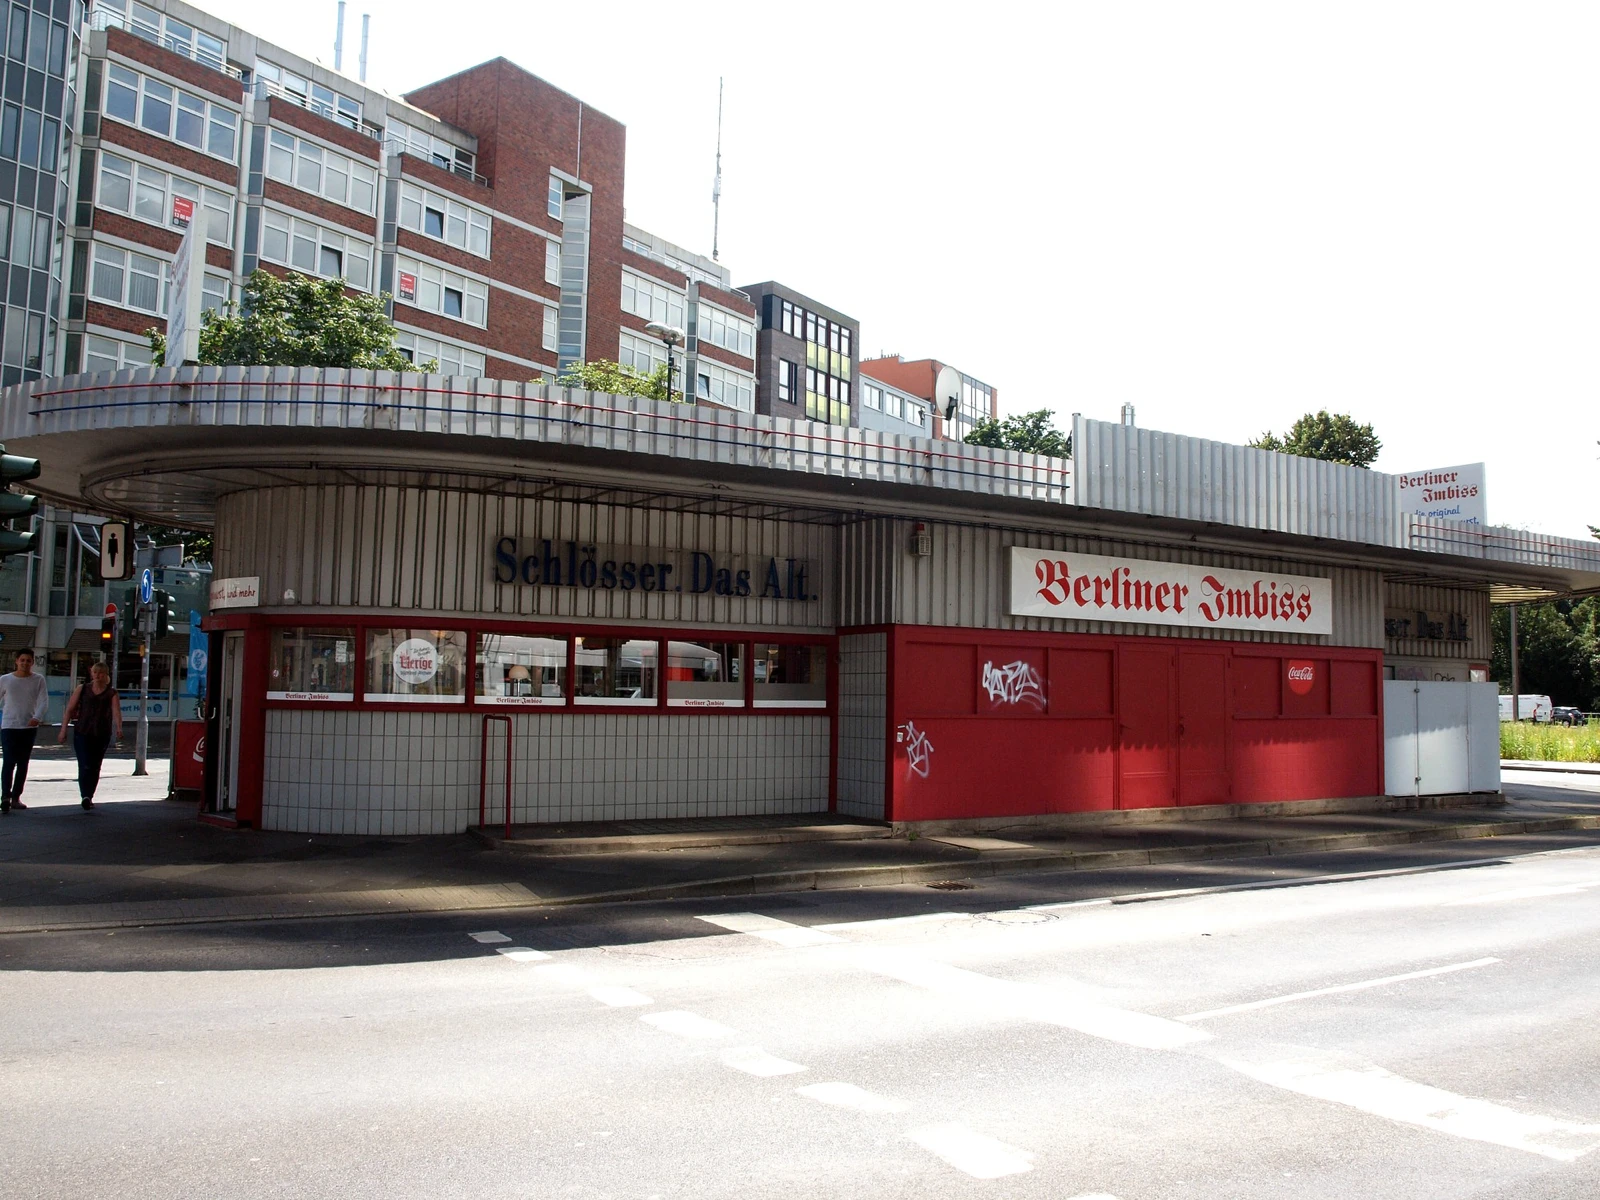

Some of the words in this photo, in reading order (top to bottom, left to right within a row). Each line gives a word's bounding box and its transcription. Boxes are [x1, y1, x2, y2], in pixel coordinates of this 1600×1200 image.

[1422, 484, 1478, 503] Imbiss
[1428, 505, 1460, 518] original
[493, 537, 682, 592] Schlösser.
[690, 551, 751, 596] Das
[759, 556, 818, 600] Alt.
[239, 585, 256, 598] mehr
[1035, 558, 1188, 615] Berliner
[1198, 575, 1312, 623] Imbiss
